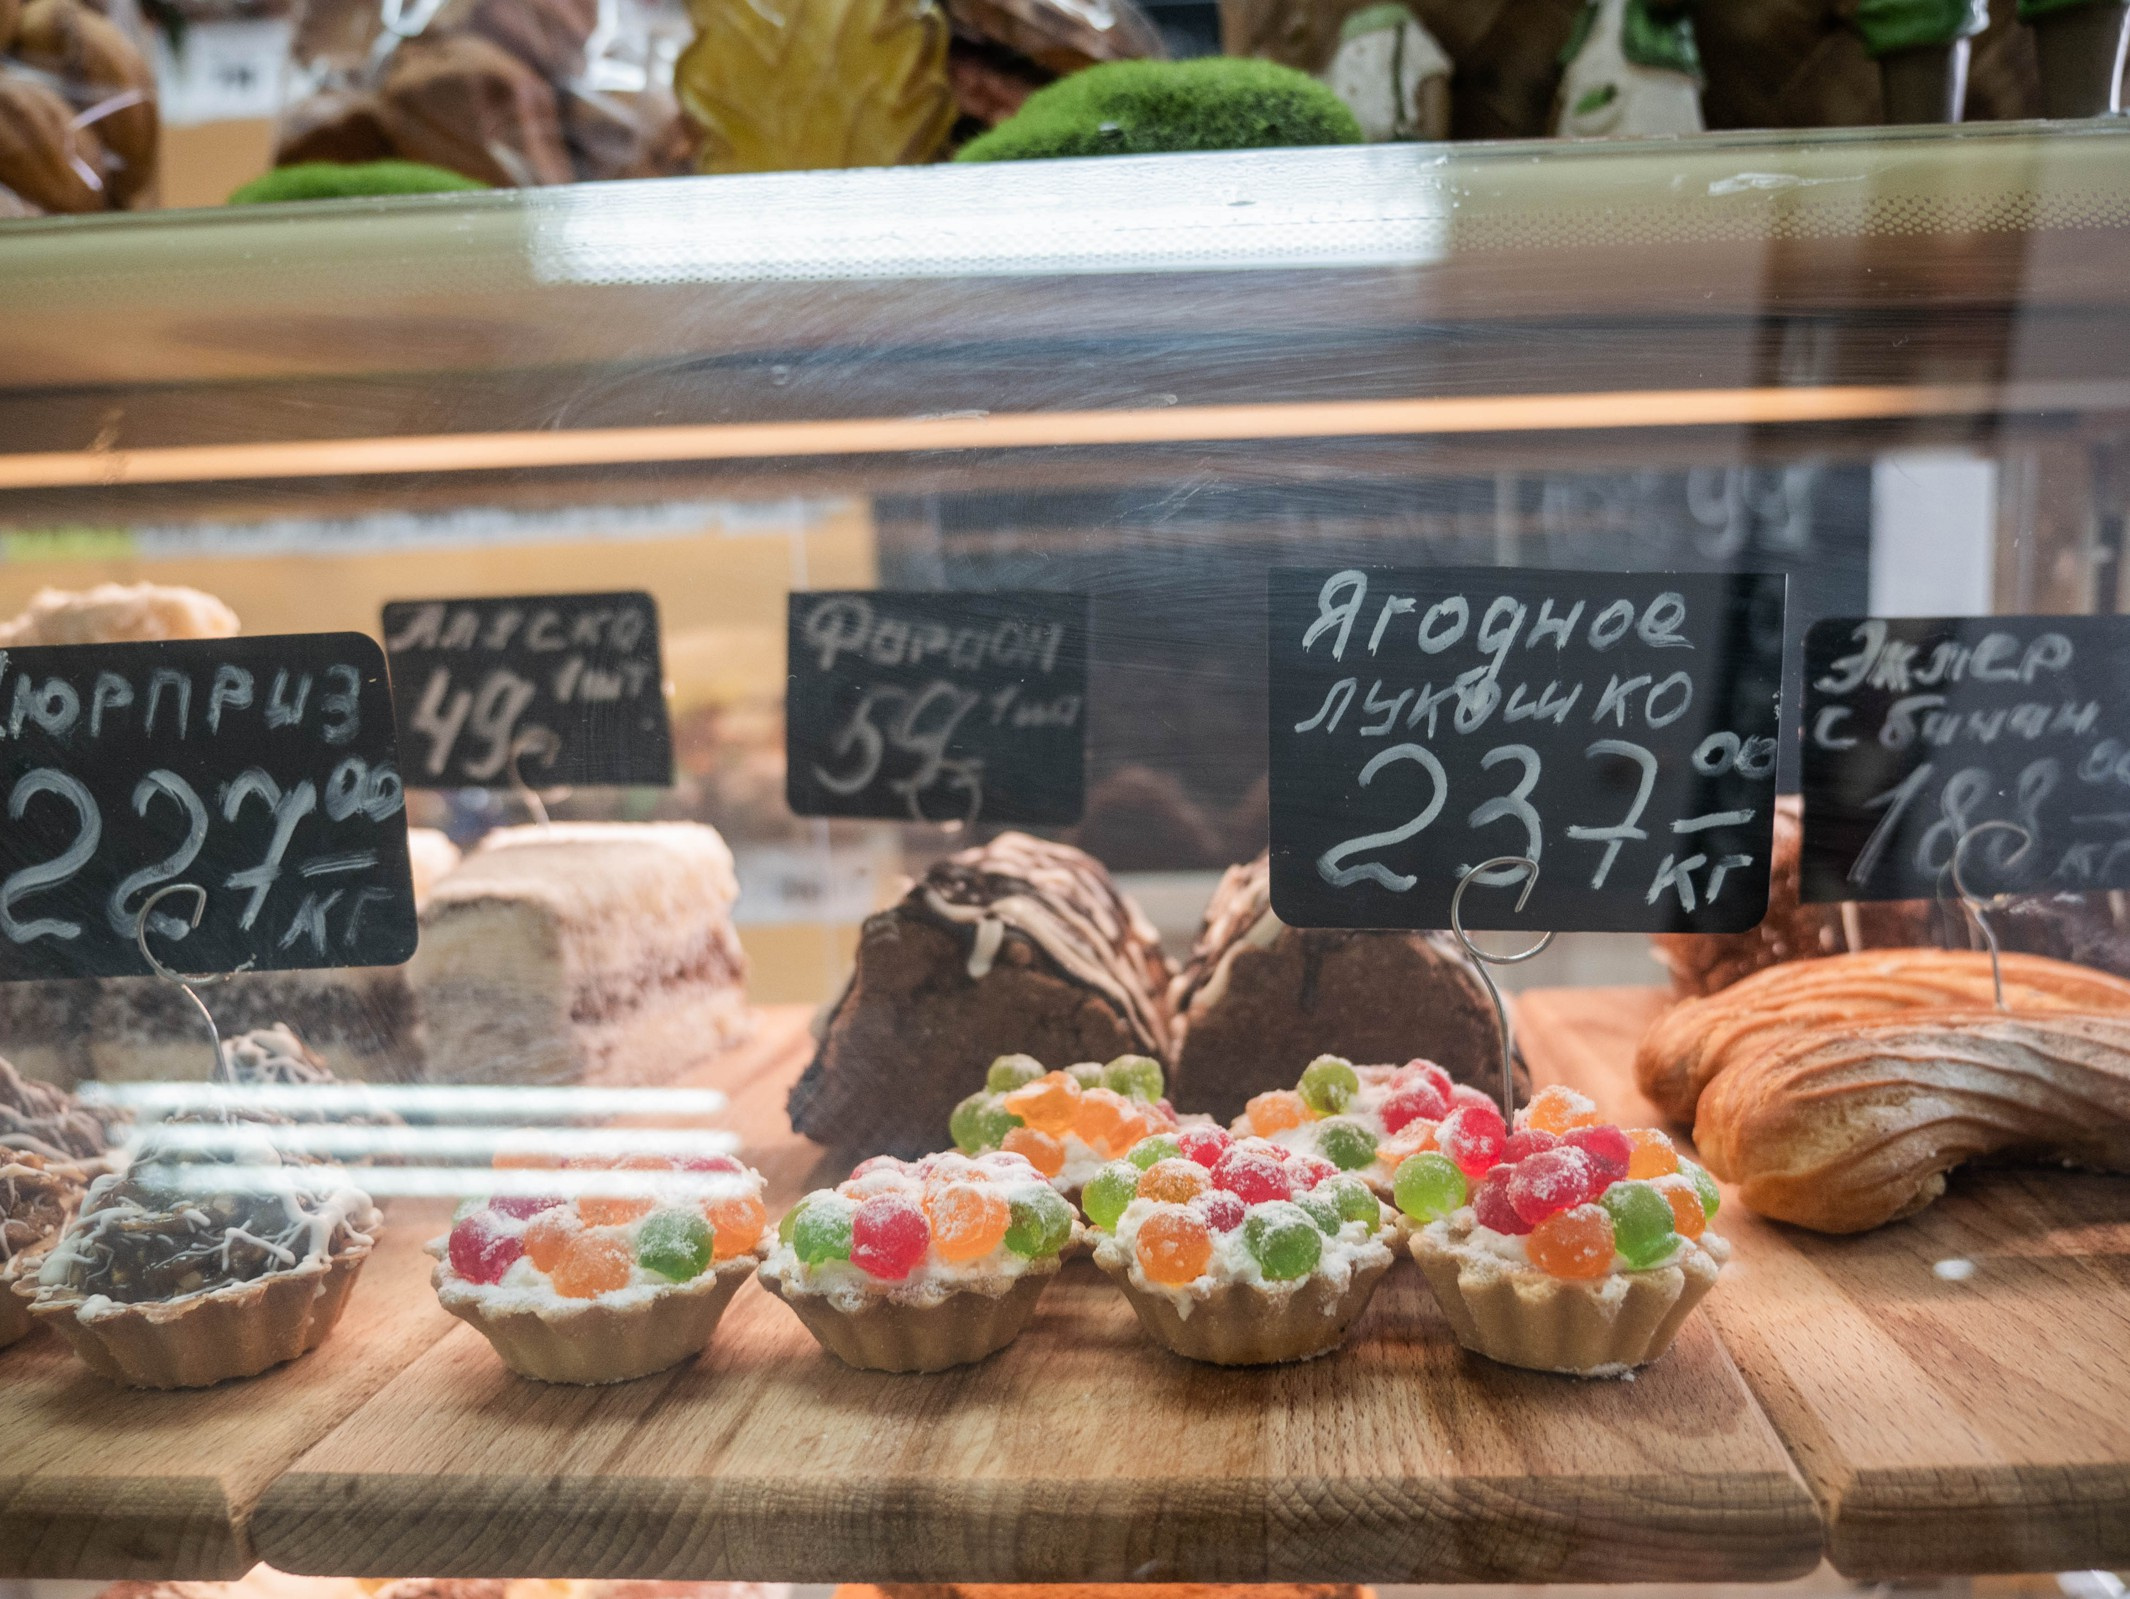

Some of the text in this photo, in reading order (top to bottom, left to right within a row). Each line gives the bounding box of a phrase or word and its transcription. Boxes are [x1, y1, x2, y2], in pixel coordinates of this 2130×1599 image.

[1302, 570, 1694, 678] Ягодное
[0, 651, 361, 744] юрприз
[410, 665, 537, 780] 49
[810, 680, 981, 795] 59
[0, 767, 317, 942] 227
[1317, 731, 1777, 892] 237 00
[1846, 757, 2060, 884] 188
[1646, 853, 1754, 913] кг
